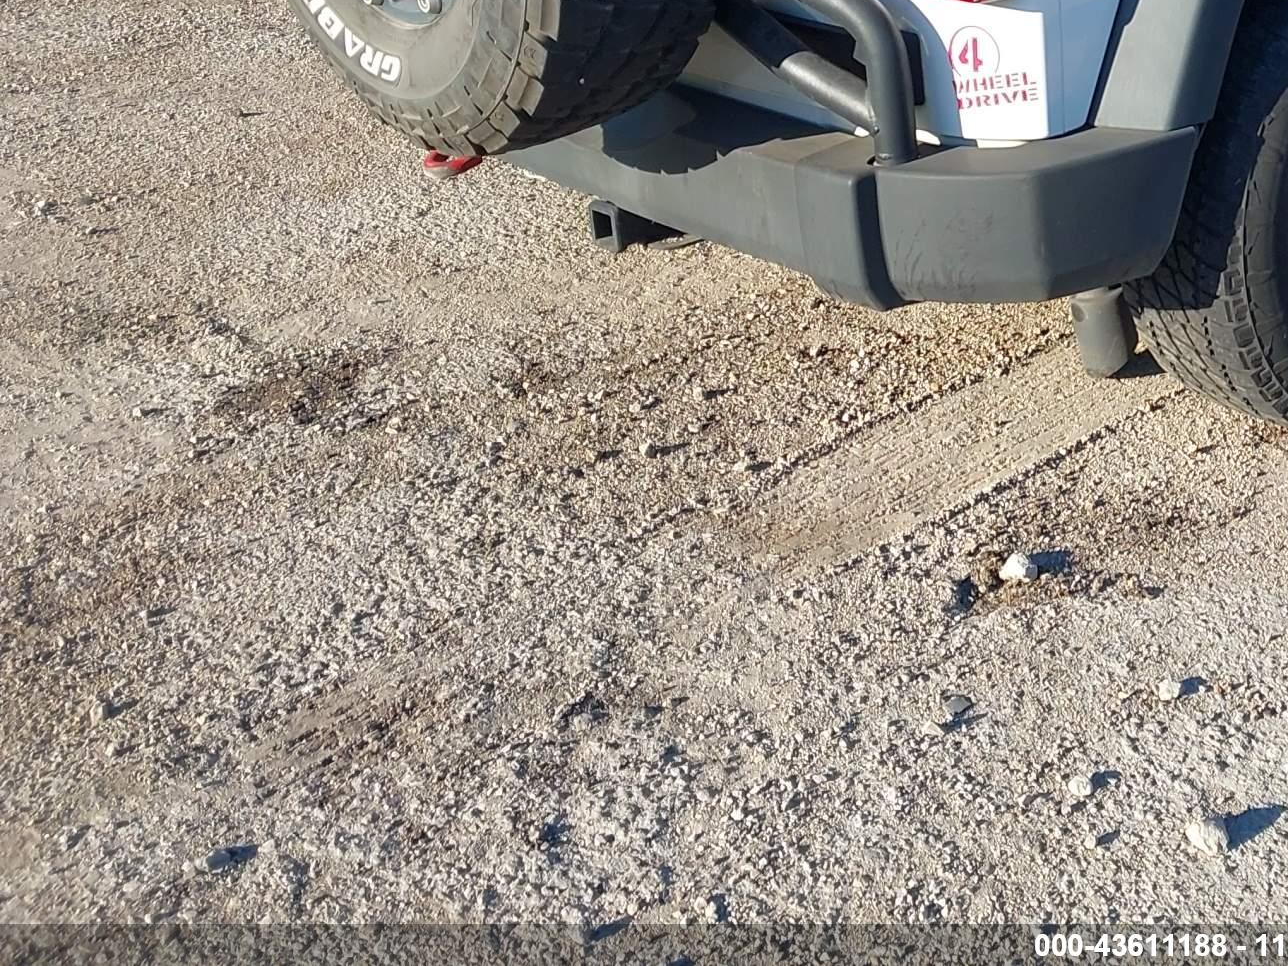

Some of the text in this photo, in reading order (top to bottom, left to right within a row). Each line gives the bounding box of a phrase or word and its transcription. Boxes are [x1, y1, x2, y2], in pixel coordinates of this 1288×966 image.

[958, 37, 983, 72] 4
[954, 72, 1037, 94] WHEEL
[957, 89, 1039, 110] DRIVE
